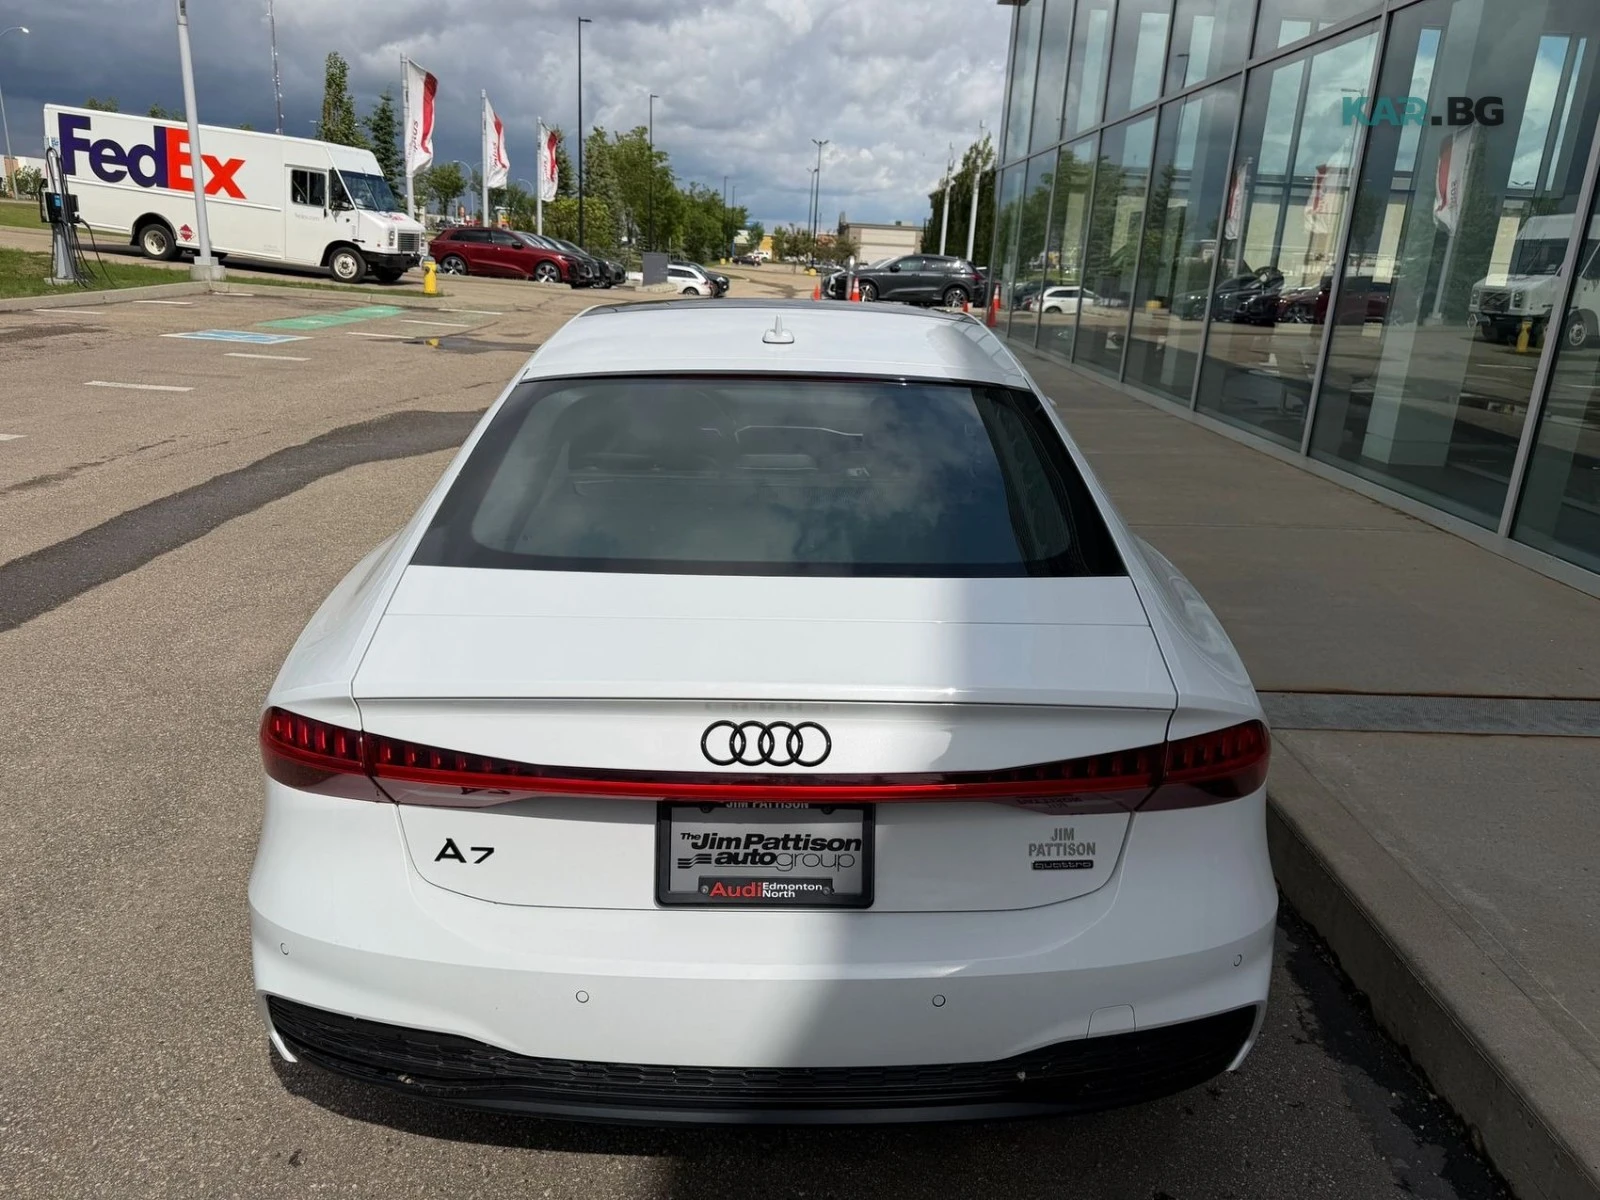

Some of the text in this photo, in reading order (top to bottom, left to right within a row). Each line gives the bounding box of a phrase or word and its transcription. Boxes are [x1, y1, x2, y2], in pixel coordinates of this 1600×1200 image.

[58, 112, 246, 200] FedEx
[1051, 827, 1075, 841] JIM
[680, 832, 862, 851] The Jim Pattison
[434, 838, 494, 864] A7
[1028, 842, 1096, 856] PATTISON
[1034, 861, 1092, 870] quattro
[709, 881, 762, 897] Audi
[762, 882, 823, 891] Edmonton
[762, 890, 796, 898] North
